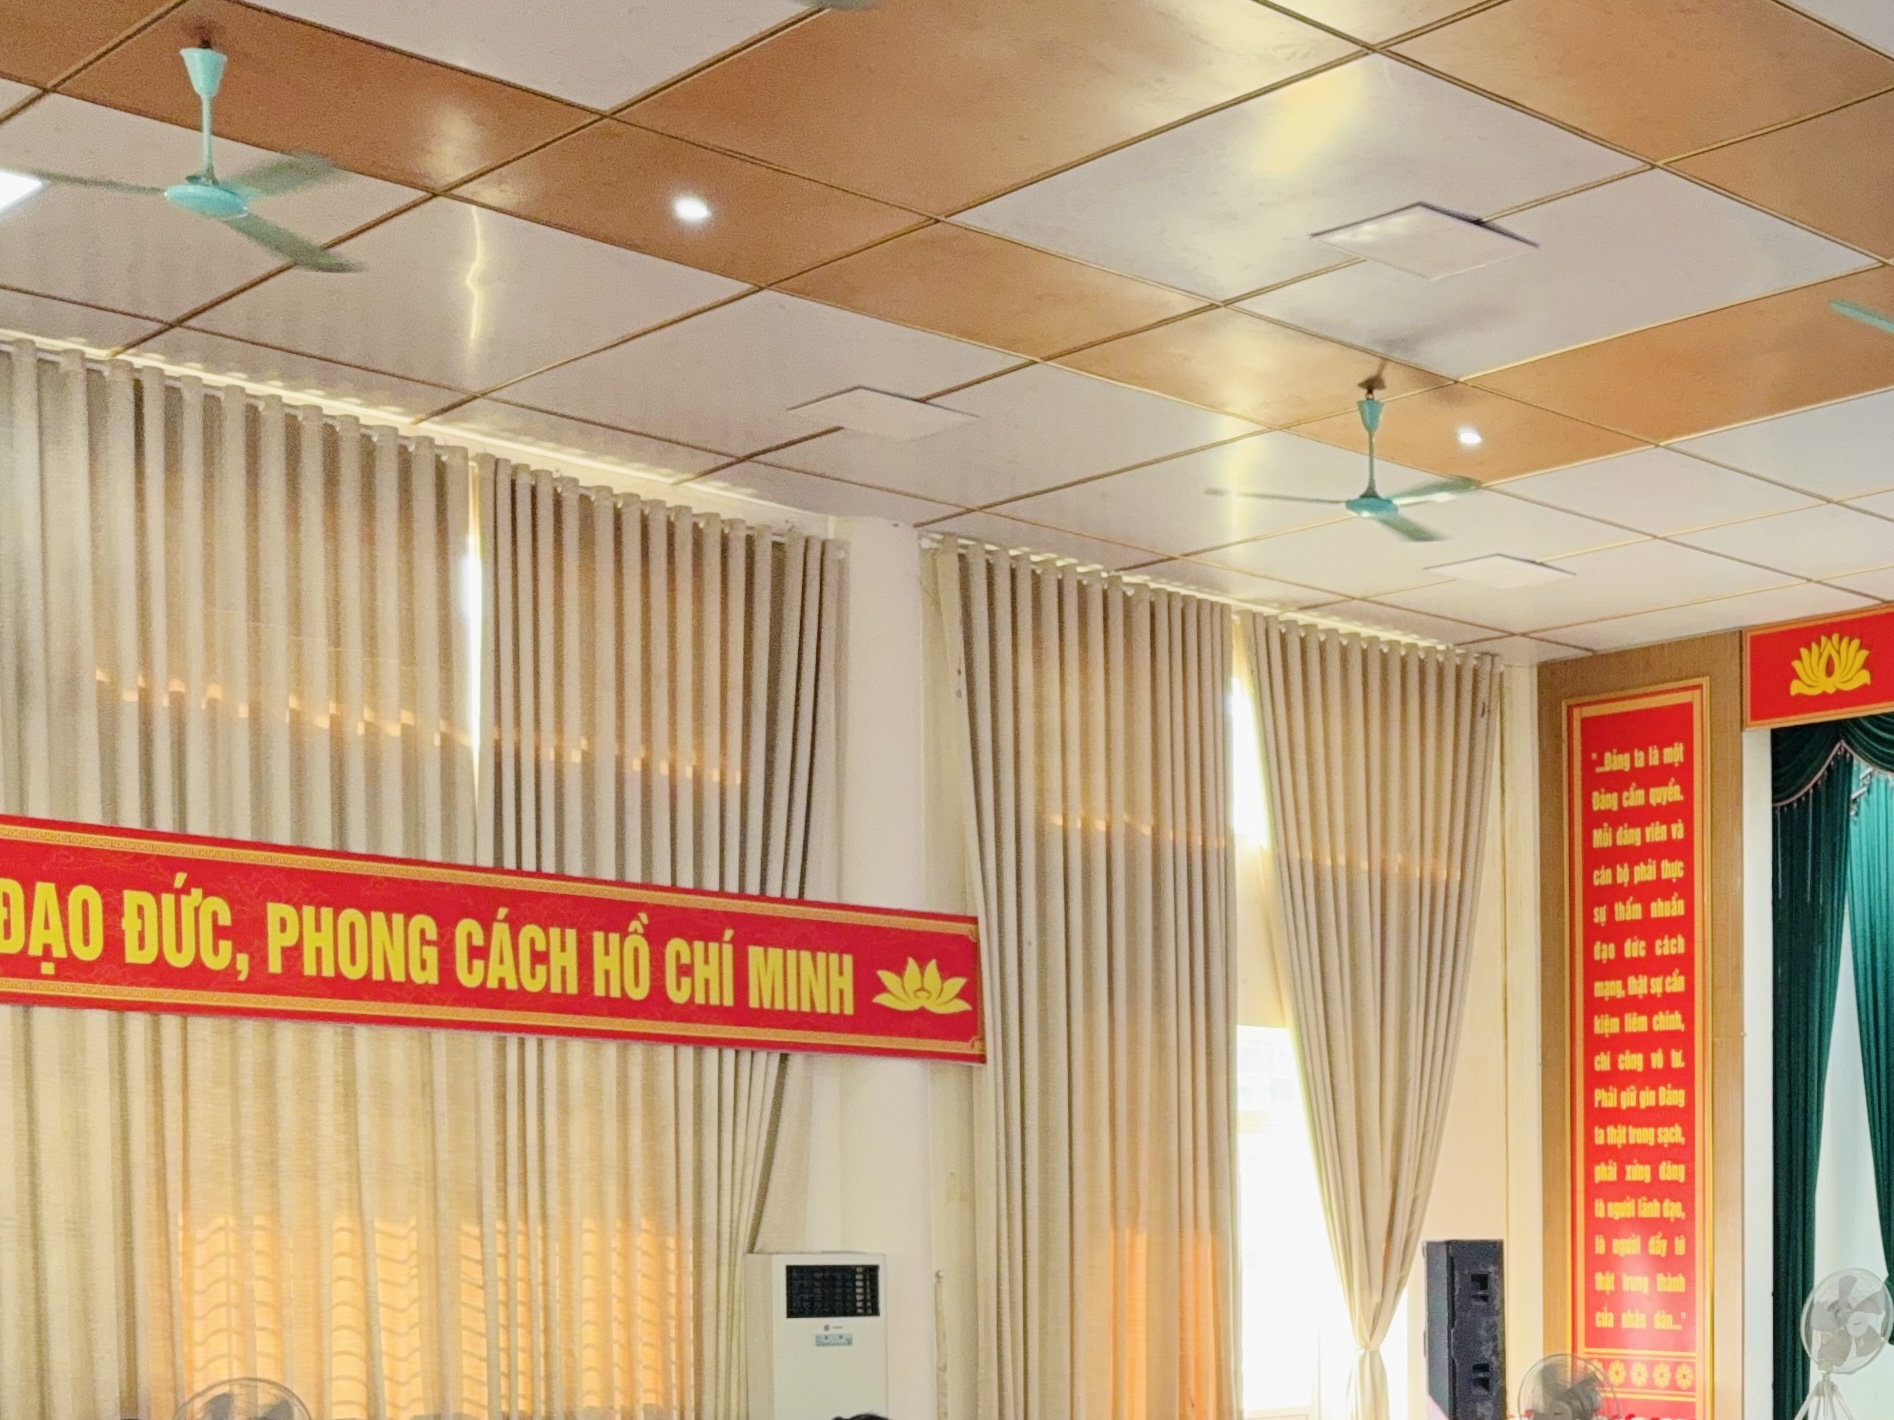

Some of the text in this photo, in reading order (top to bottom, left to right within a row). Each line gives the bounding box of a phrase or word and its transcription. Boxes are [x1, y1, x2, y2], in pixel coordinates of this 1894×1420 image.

[1634, 749, 1645, 768] ta
[1648, 745, 1660, 766] là
[1663, 742, 1684, 767] một
[1593, 788, 1618, 811] Đảng
[1616, 823, 1641, 846] đảng
[1645, 821, 1667, 843] viên
[1671, 819, 1684, 839] và
[1593, 858, 1684, 887] cán bộ phải thực
[1594, 905, 1606, 926] sự
[0, 872, 854, 1015] ĐẠO ĐỨC, PHONG CÁCH HỒ CHÍ MINH
[1594, 934, 1685, 963] đạo đức cách
[1594, 980, 1625, 1001] mạng,
[1628, 975, 1648, 999] thật
[1650, 976, 1664, 998] sự
[1594, 1010, 1684, 1037] kiệm liêm chính,
[1594, 1051, 1610, 1071] chí
[1618, 1050, 1643, 1072] công
[1651, 1048, 1664, 1069] vô
[1595, 1086, 1617, 1107] Phải
[1621, 1085, 1636, 1110] giữ
[1659, 1083, 1684, 1108] Đảng
[1595, 1123, 1684, 1148] ta thật trong sạch,
[1594, 1160, 1617, 1183] phải
[1659, 1161, 1685, 1183] đáng
[1595, 1199, 1604, 1217] là
[1608, 1197, 1635, 1220] người
[1663, 1199, 1685, 1222] đạo,
[1596, 1232, 1606, 1255] là
[1613, 1232, 1641, 1256] người
[1596, 1271, 1615, 1294] thật
[1657, 1271, 1686, 1292] thành
[1596, 1302, 1615, 1328] của
